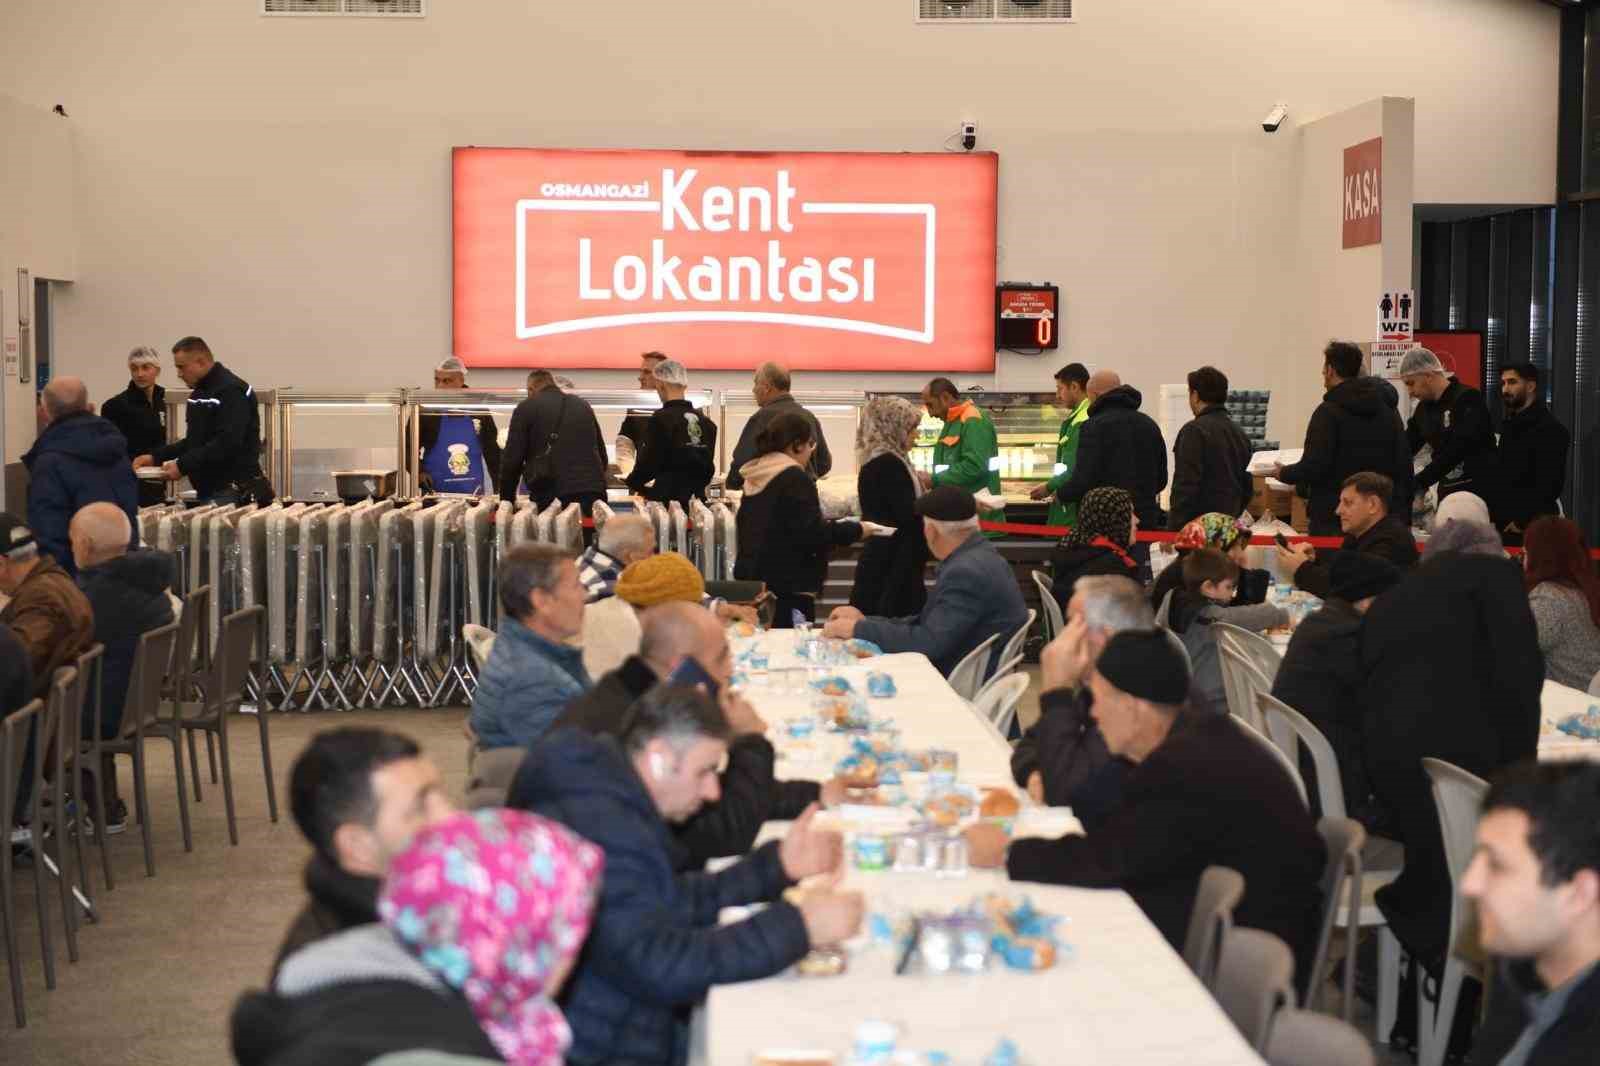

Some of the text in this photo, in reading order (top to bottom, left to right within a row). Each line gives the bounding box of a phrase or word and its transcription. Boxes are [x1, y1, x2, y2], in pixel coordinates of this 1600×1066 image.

[541, 180, 649, 198] OSMANGAZİ
[661, 168, 795, 233] Kent
[1344, 168, 1380, 221] KASA
[578, 238, 875, 304] Lokantası
[1038, 318, 1051, 344] 0
[1382, 322, 1409, 331] WC
